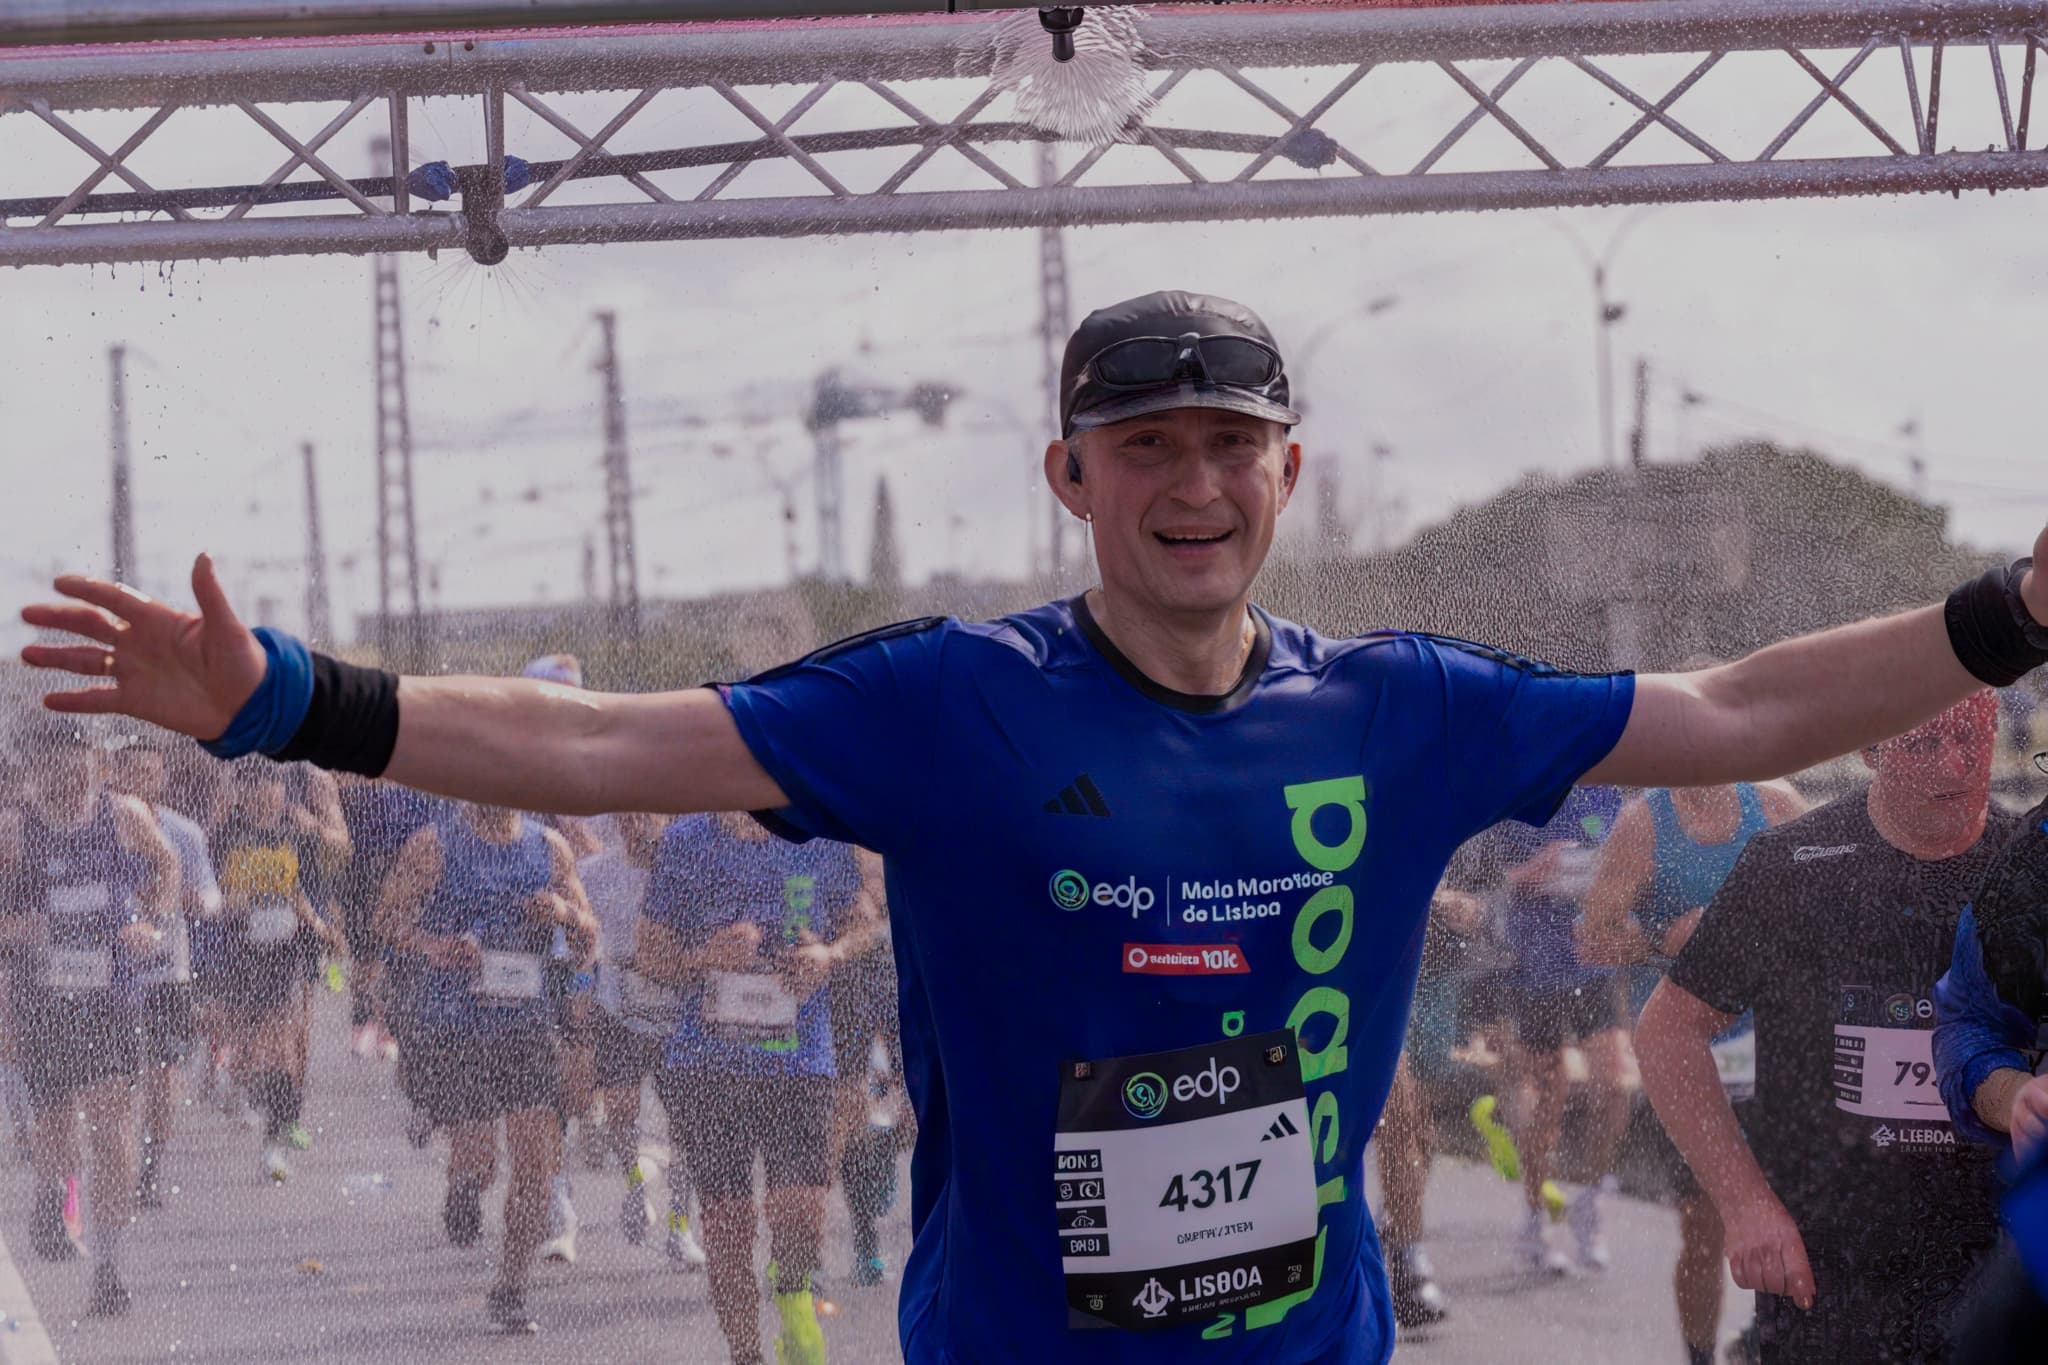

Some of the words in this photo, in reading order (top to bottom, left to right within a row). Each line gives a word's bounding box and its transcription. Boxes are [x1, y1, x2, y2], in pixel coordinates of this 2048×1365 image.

[1092, 876, 1155, 919] edp
[1172, 1056, 1241, 1104] edp
[1893, 1060, 1938, 1087] 79
[1159, 1159, 1263, 1212] 4317
[1179, 1265, 1263, 1301] LISBOA
